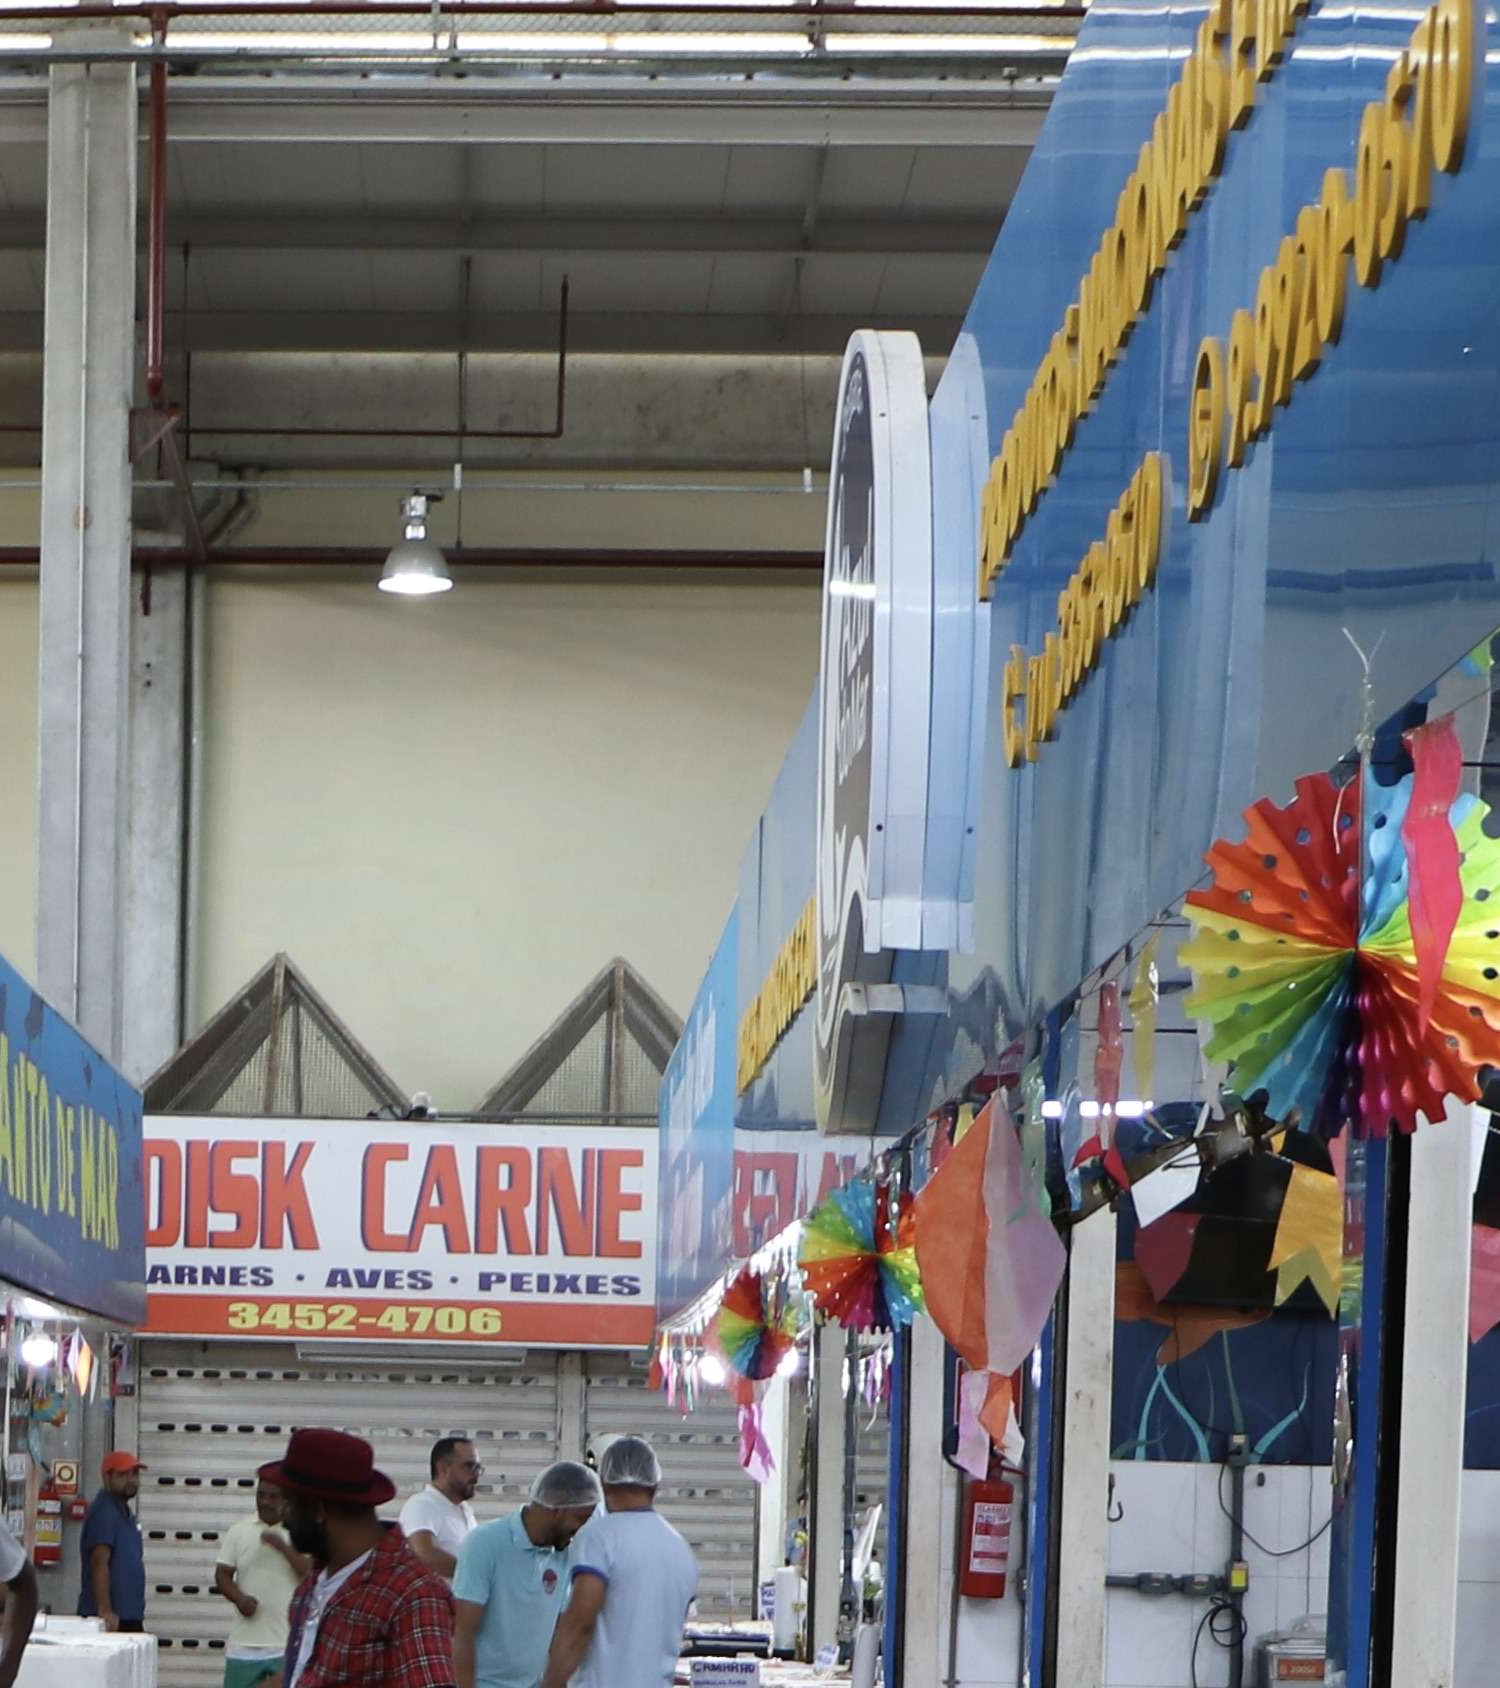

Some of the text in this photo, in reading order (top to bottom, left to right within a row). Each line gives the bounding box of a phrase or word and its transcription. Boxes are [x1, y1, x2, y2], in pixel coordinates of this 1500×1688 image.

[55, 1108, 78, 1219] DE
[81, 1118, 120, 1252] MAR
[144, 1137, 320, 1252] DISK
[359, 1142, 645, 1259] CARNE
[227, 1301, 503, 1335] 3452-4706
[325, 1266, 434, 1292] AVES
[477, 1271, 643, 1297] PEIXES
